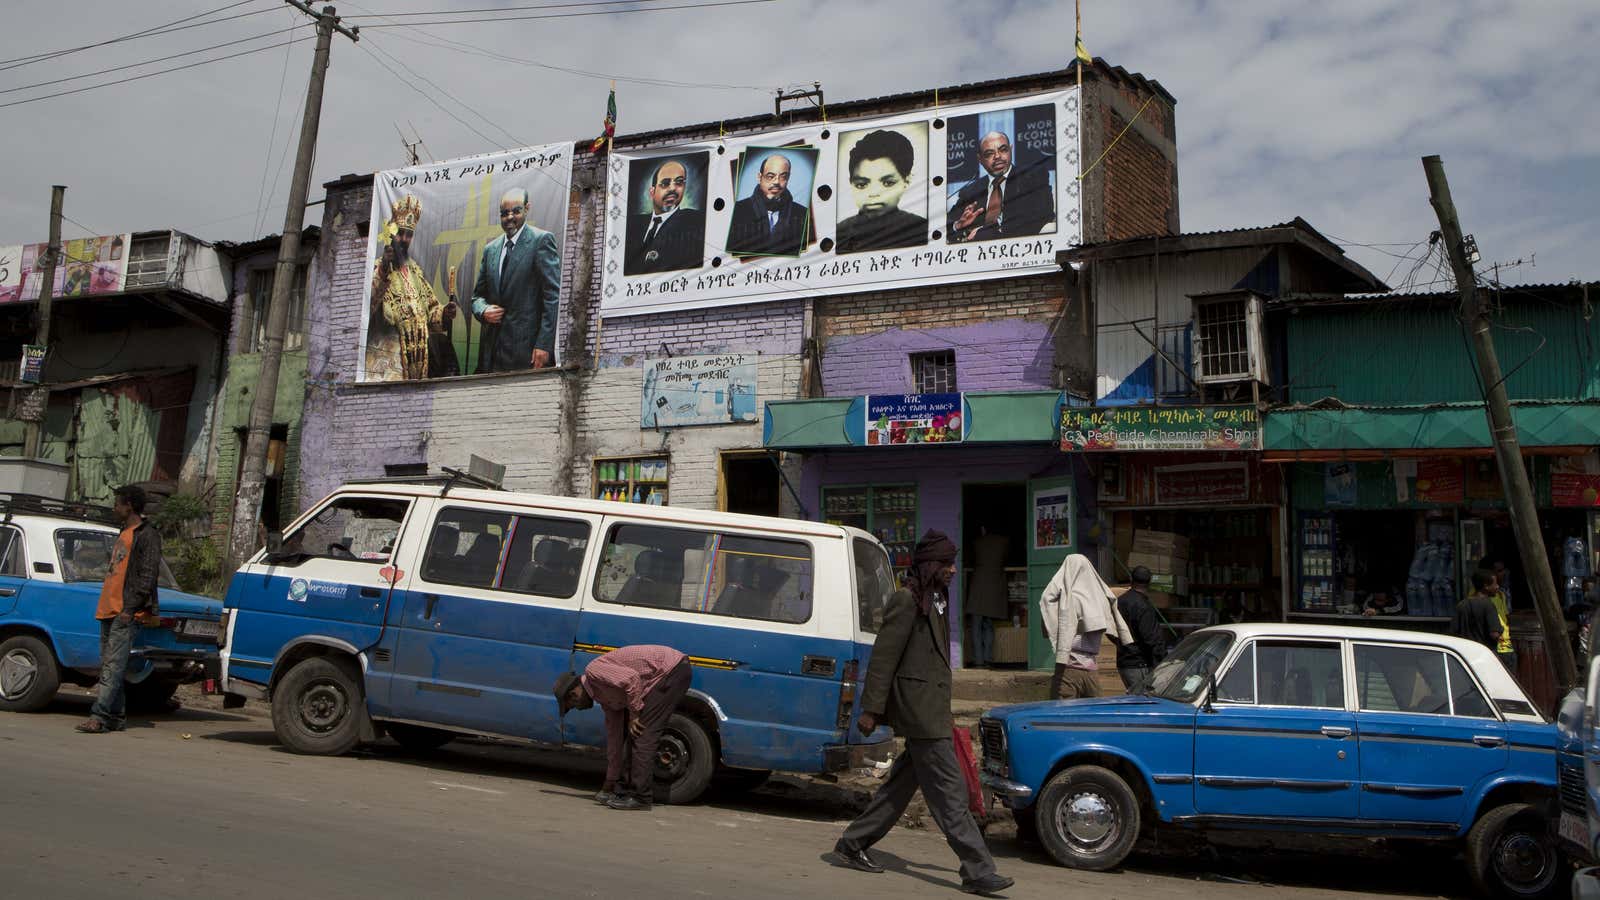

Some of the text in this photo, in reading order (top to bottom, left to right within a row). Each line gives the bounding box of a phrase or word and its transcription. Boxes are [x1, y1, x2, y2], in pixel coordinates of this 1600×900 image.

[1064, 427, 1258, 443] G2 Pesticide Chemicals Shop
